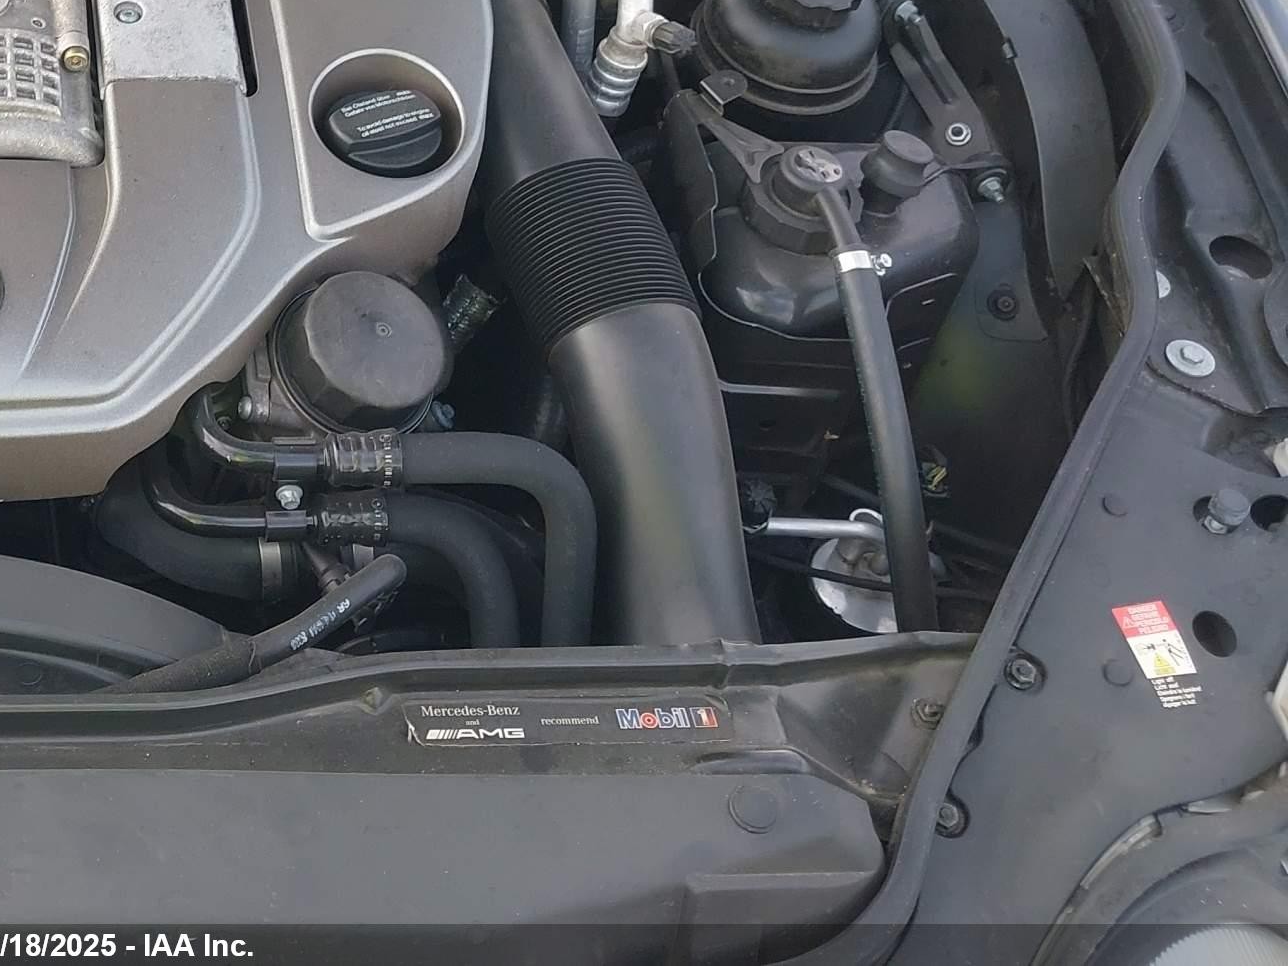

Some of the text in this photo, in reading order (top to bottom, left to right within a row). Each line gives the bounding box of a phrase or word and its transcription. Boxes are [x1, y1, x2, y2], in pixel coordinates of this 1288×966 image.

[421, 705, 520, 718] Mercedes-Benz
[540, 717, 600, 726] recommend
[616, 708, 690, 730] Mobil
[456, 727, 525, 740] AMG
